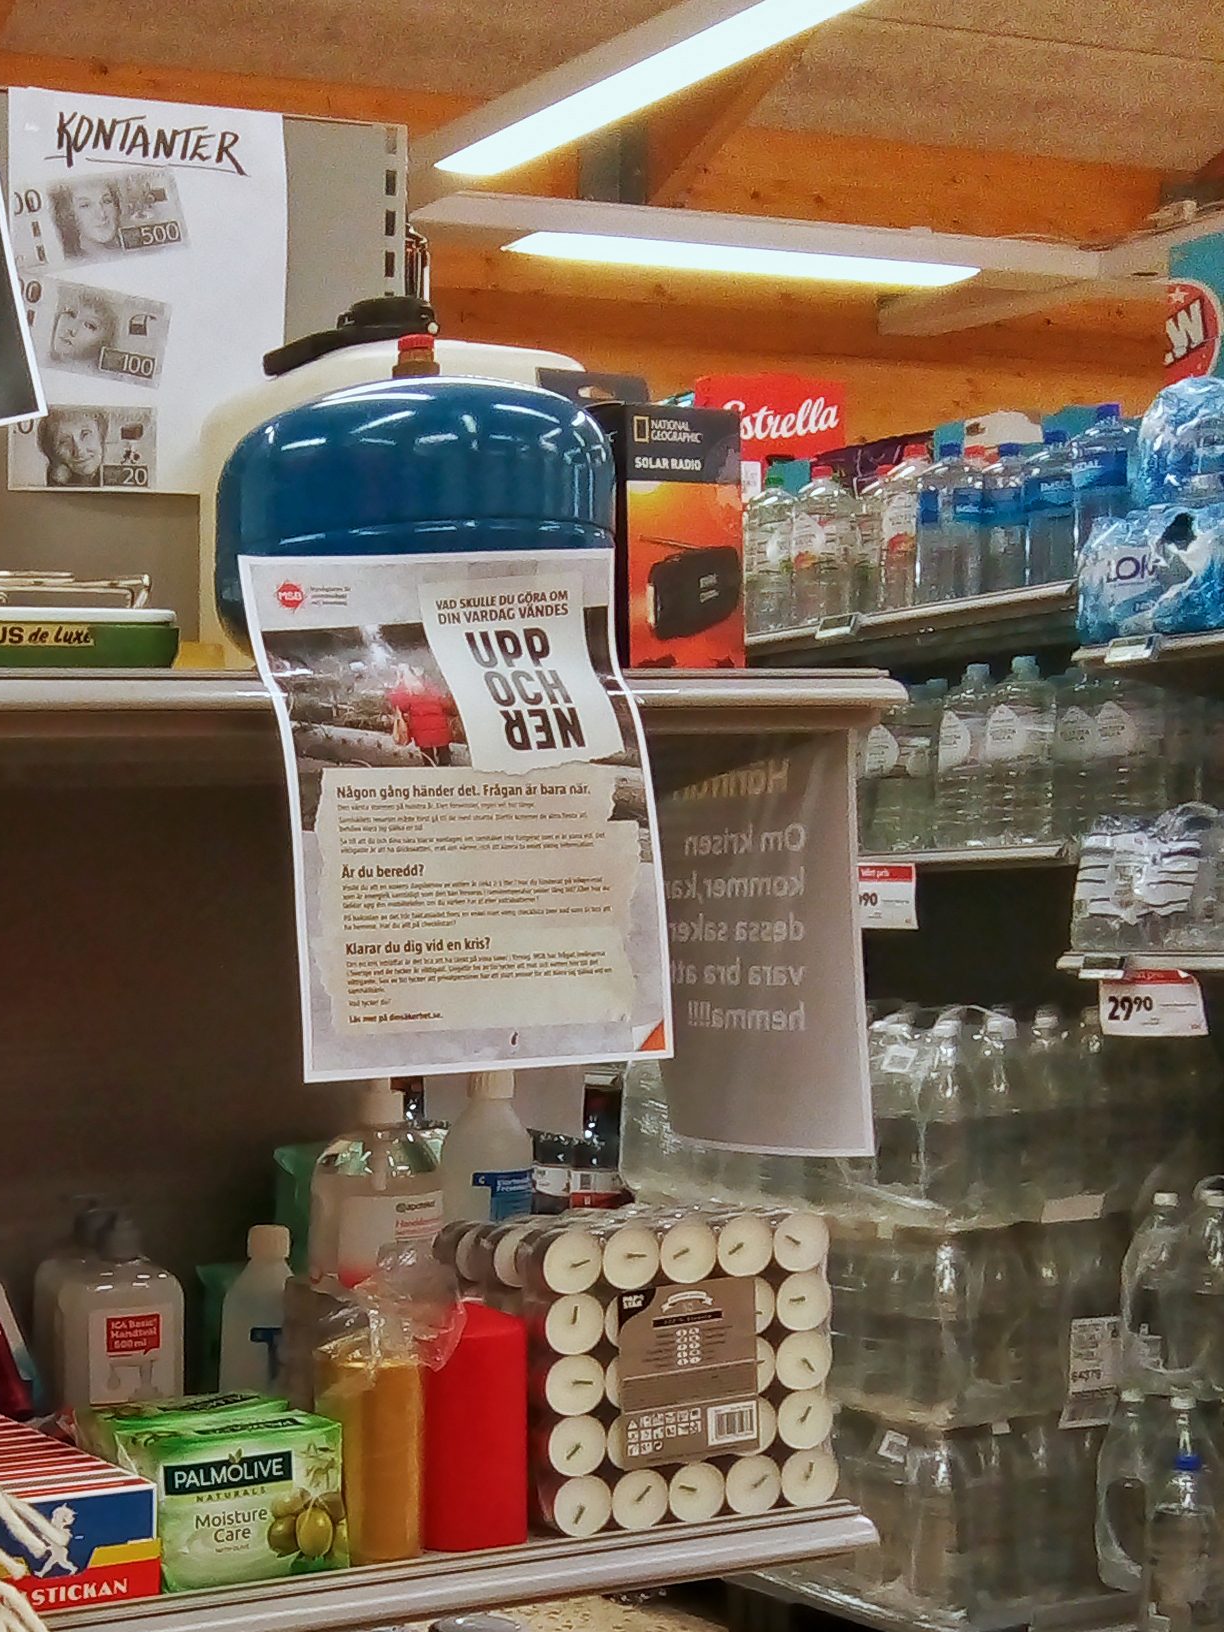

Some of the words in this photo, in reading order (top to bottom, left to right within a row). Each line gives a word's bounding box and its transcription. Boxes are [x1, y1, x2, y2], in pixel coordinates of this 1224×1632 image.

[56, 111, 250, 177] KONTANTER
[141, 220, 180, 246] 500
[122, 354, 156, 377] 100
[651, 419, 691, 432] NATIONAL
[650, 429, 703, 444] GEOGRAPHIC
[634, 457, 668, 470] SOLAR
[670, 457, 702, 471] RADIO
[122, 467, 148, 487] 20
[436, 598, 458, 611] VAD
[460, 595, 497, 610] SKULLE
[499, 594, 516, 607] DU
[549, 590, 569, 604] OM
[437, 610, 462, 625] DIN
[464, 606, 516, 624] VARDAG
[518, 602, 570, 620] VÄNDES
[28, 626, 49, 645] de
[464, 626, 551, 669] UPP
[483, 670, 573, 708] OCH
[501, 707, 586, 752] NER
[336, 785, 377, 801] Någon
[379, 784, 410, 800] gång
[412, 783, 455, 798] händer
[457, 783, 481, 798] det.
[482, 782, 523, 800] Frågan
[525, 783, 538, 797] är
[540, 782, 567, 797] bara
[569, 783, 592, 796] när.
[341, 863, 355, 880] Är
[357, 864, 374, 879] du
[375, 863, 425, 879] beredd?
[345, 941, 382, 956] Klarar
[385, 940, 401, 954] du
[403, 939, 423, 956] dig
[425, 938, 444, 952] vid
[446, 940, 462, 952] en
[464, 936, 491, 951] kris?
[174, 1456, 284, 1490] PALMOLIVE
[196, 1486, 267, 1503] NATURALS
[195, 1507, 268, 1529] Moisture
[213, 1526, 252, 1544] Care
